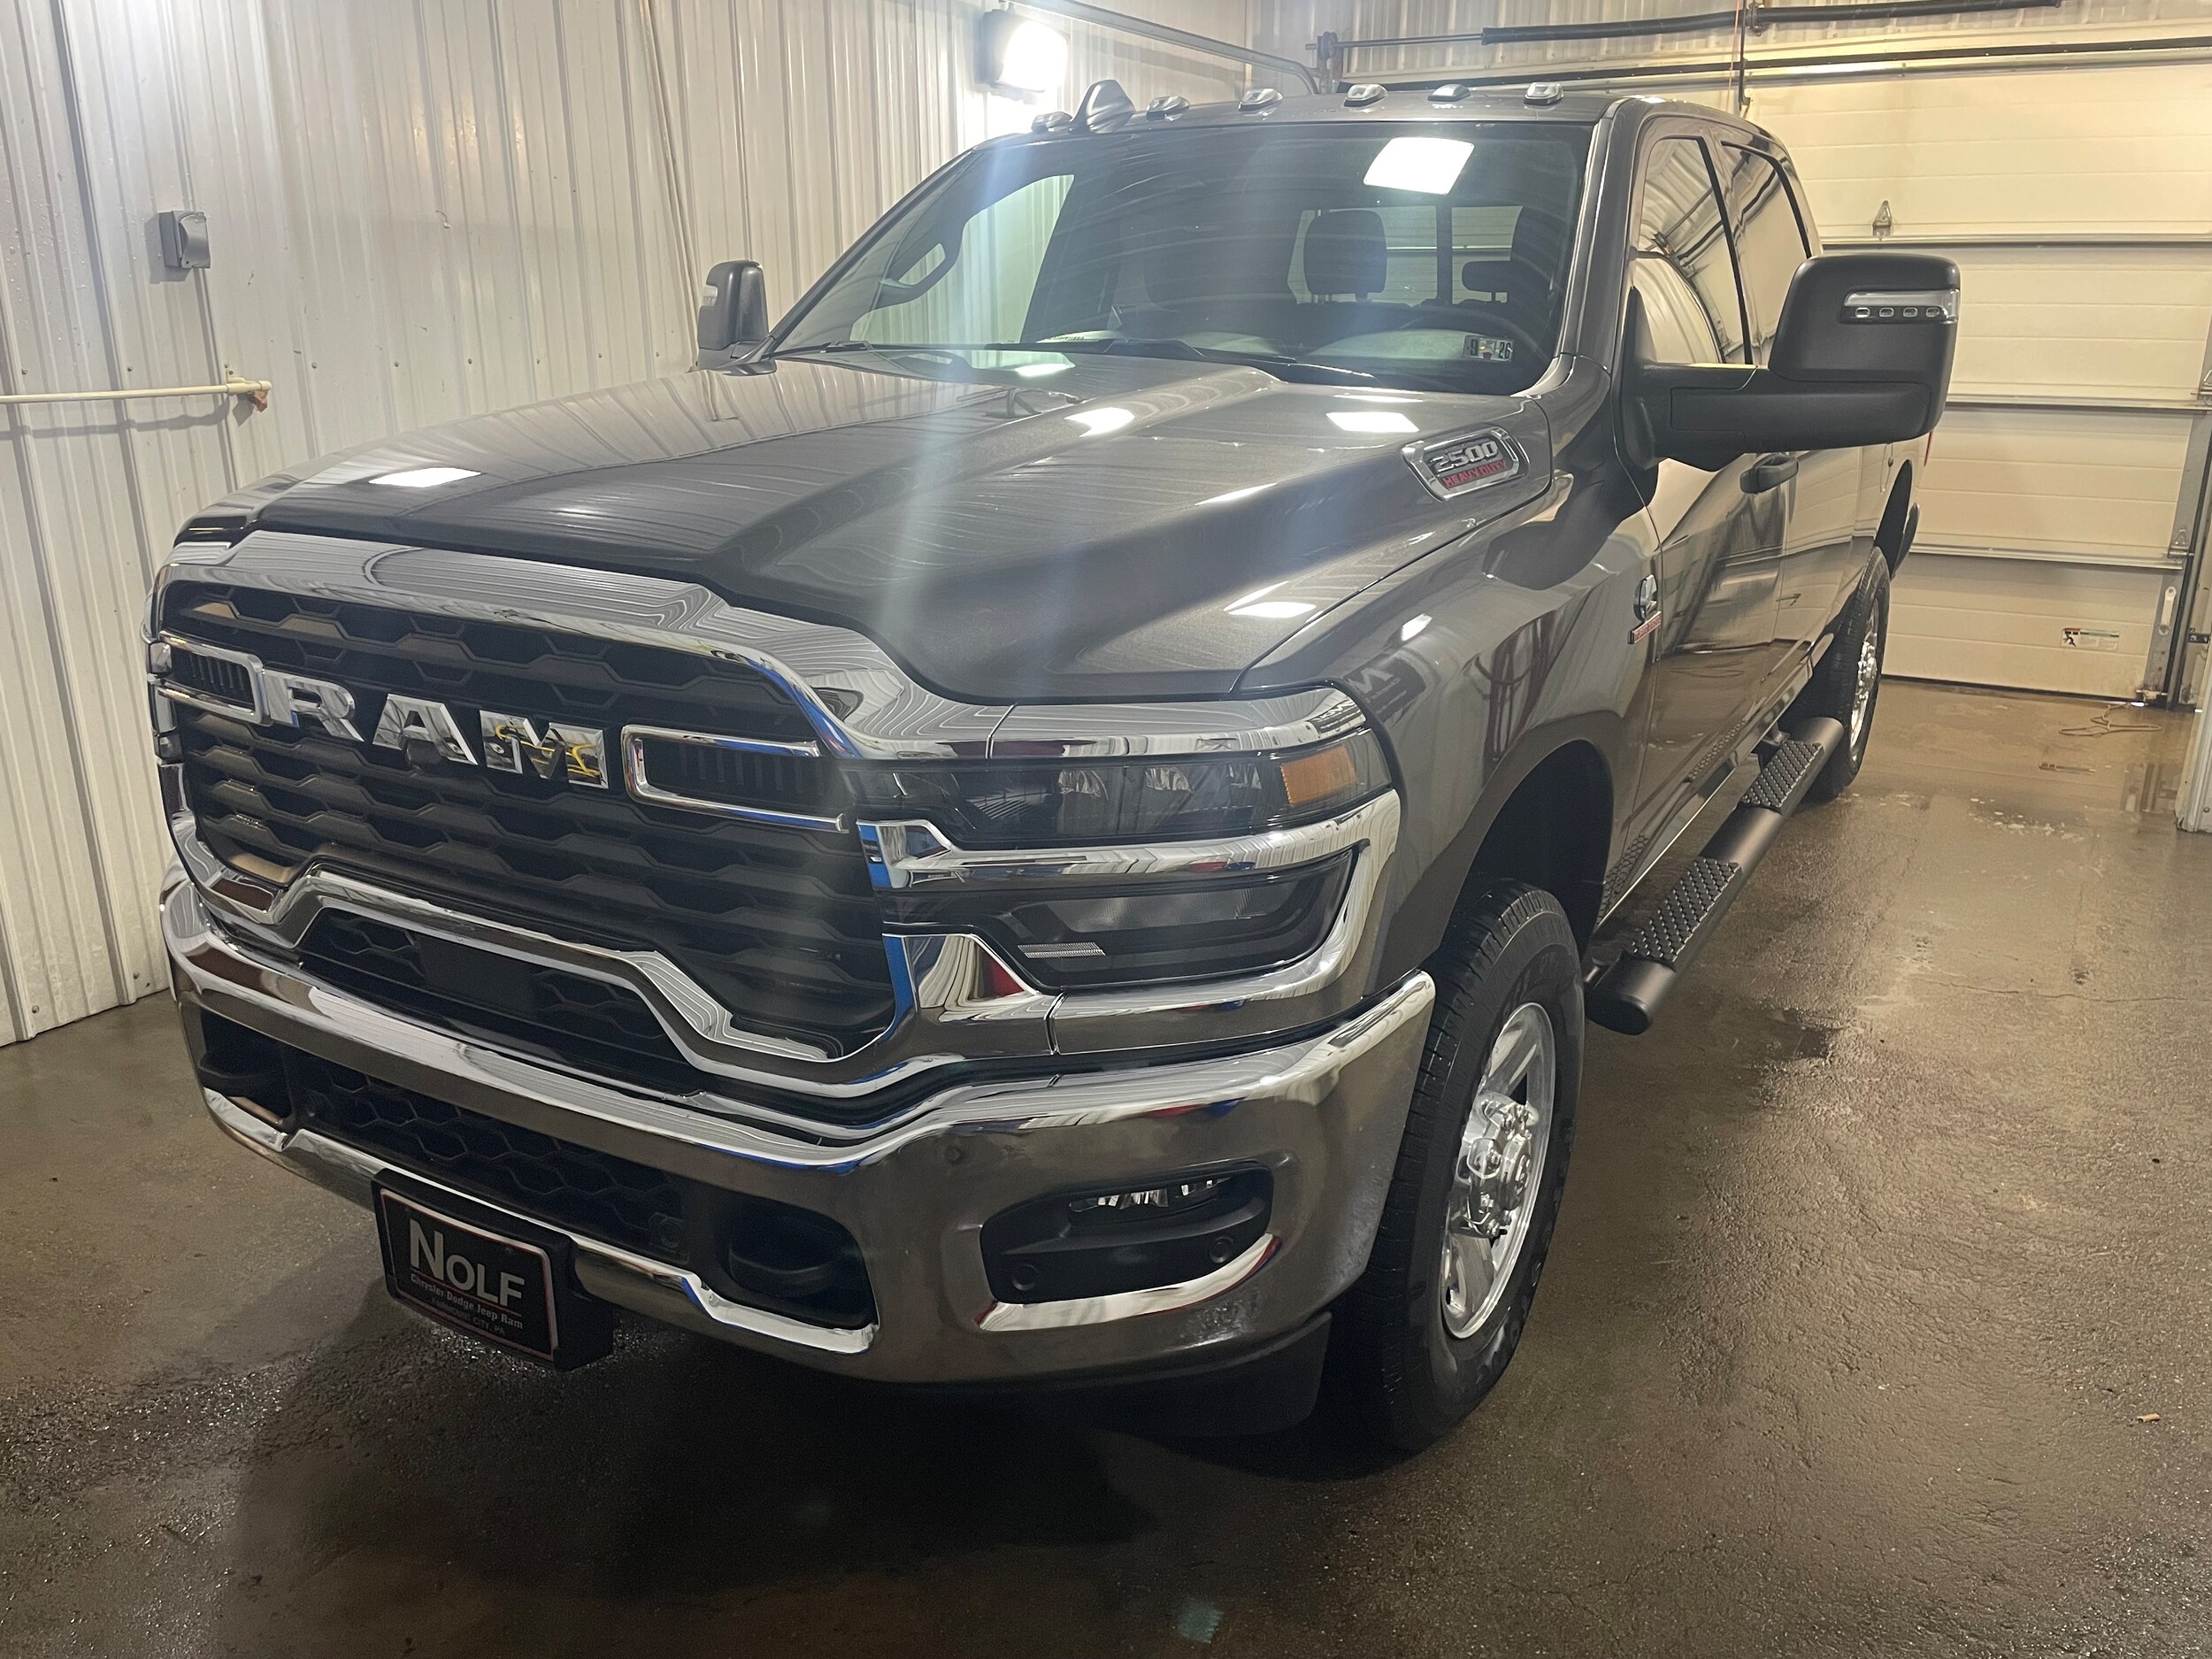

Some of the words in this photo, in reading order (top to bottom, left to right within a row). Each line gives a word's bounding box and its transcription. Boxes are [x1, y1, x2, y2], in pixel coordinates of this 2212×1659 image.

[1498, 342, 1512, 359] 26
[1431, 441, 1499, 472] 2500
[1442, 468, 1480, 488] HEAVY
[1479, 459, 1508, 477] DUTY
[262, 667, 609, 790] RAM
[410, 1218, 525, 1307] NOLF
[411, 1273, 445, 1297] Chrysler
[447, 1291, 477, 1310] Dodge
[477, 1305, 498, 1321] Jeep
[501, 1314, 524, 1330] Ram
